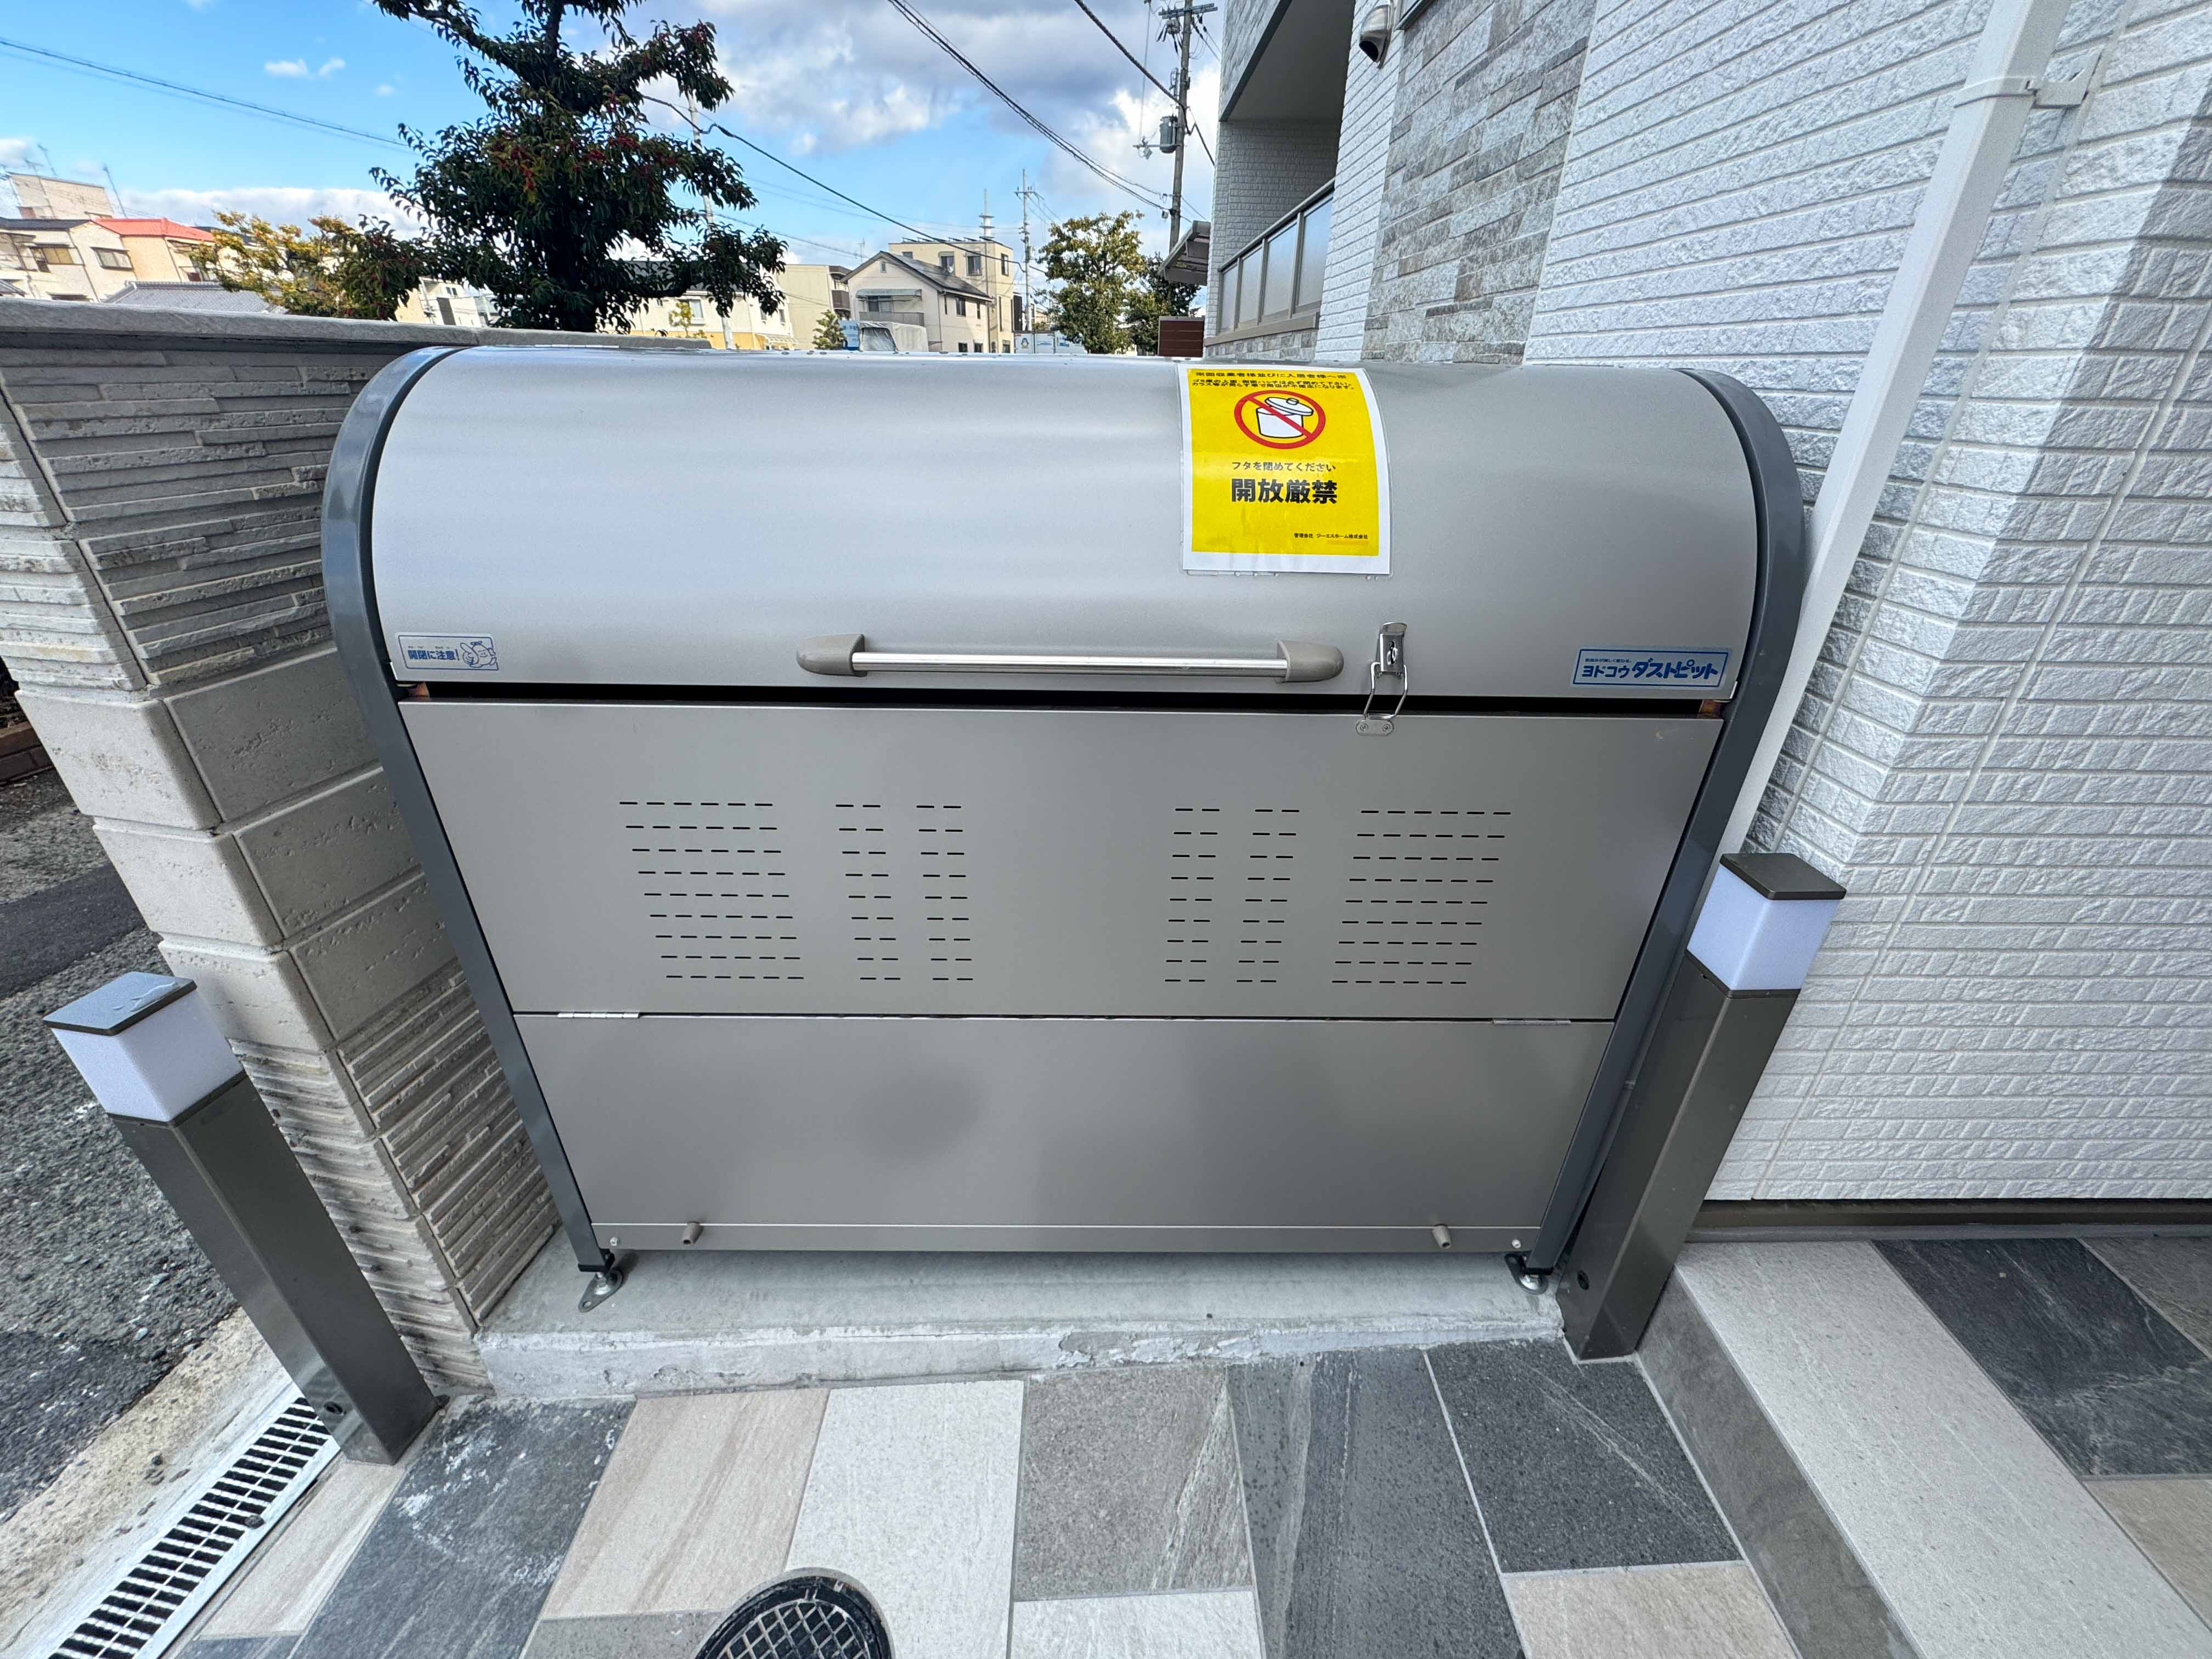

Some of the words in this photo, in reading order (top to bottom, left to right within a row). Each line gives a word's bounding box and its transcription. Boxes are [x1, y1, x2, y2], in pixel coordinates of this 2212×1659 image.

[1232, 461, 1336, 472] フタを閉めてください
[1231, 478, 1338, 504] 開放厳禁
